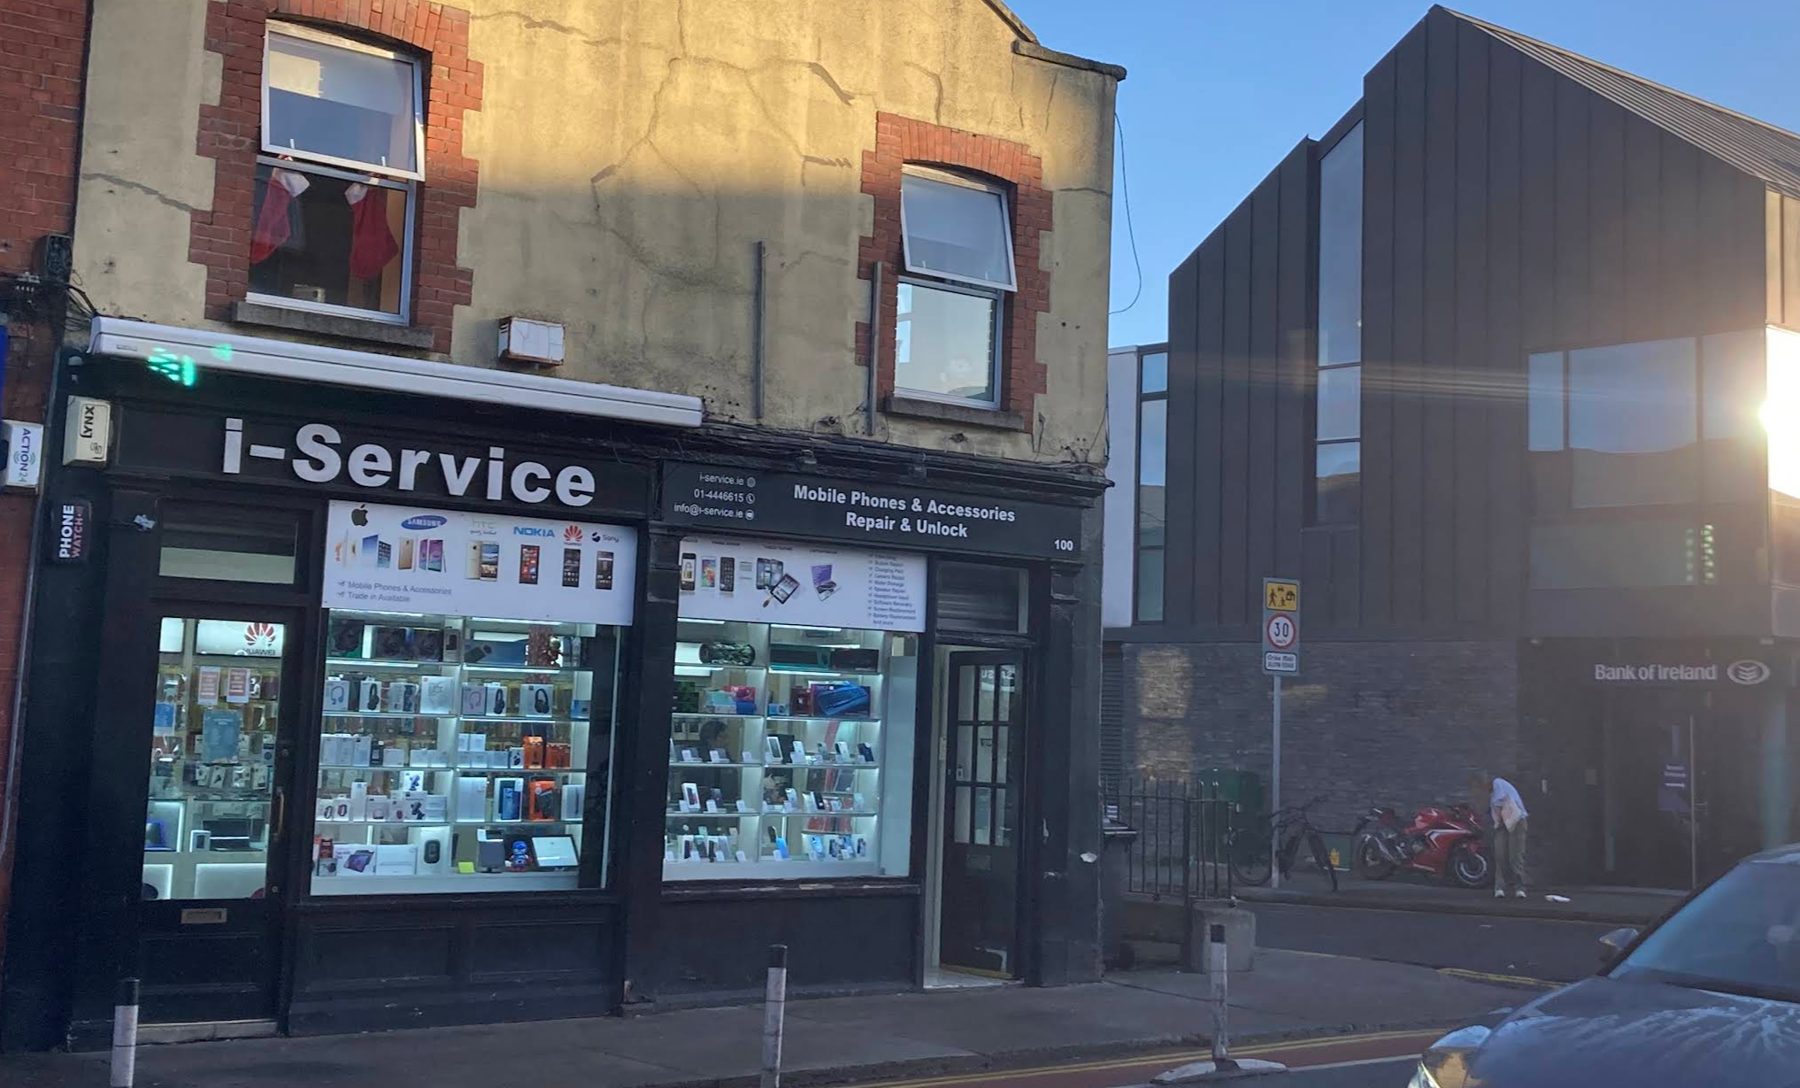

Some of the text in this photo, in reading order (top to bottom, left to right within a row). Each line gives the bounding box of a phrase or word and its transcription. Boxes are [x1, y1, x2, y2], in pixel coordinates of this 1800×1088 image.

[80, 405, 95, 439] LYNX
[223, 417, 596, 507] i-Service
[699, 472, 744, 486] i-service.ie
[693, 488, 744, 503] 01-4446615
[793, 484, 1016, 522] Mobile Phones & Accessories
[673, 501, 744, 519] info@i-service.ie
[59, 504, 75, 558] PHONE
[513, 526, 556, 538] NOKIA
[845, 512, 968, 538] Repair & Unlock
[71, 516, 84, 558] WATCH
[602, 534, 620, 543] Sony
[1054, 539, 1074, 551] 100
[348, 581, 372, 590] Mobile
[374, 582, 400, 592] Phones
[410, 586, 452, 595] Accessories
[348, 592, 369, 600] Trade
[1274, 622, 1290, 638] 30
[1594, 664, 1718, 680] Bank of Ireland
